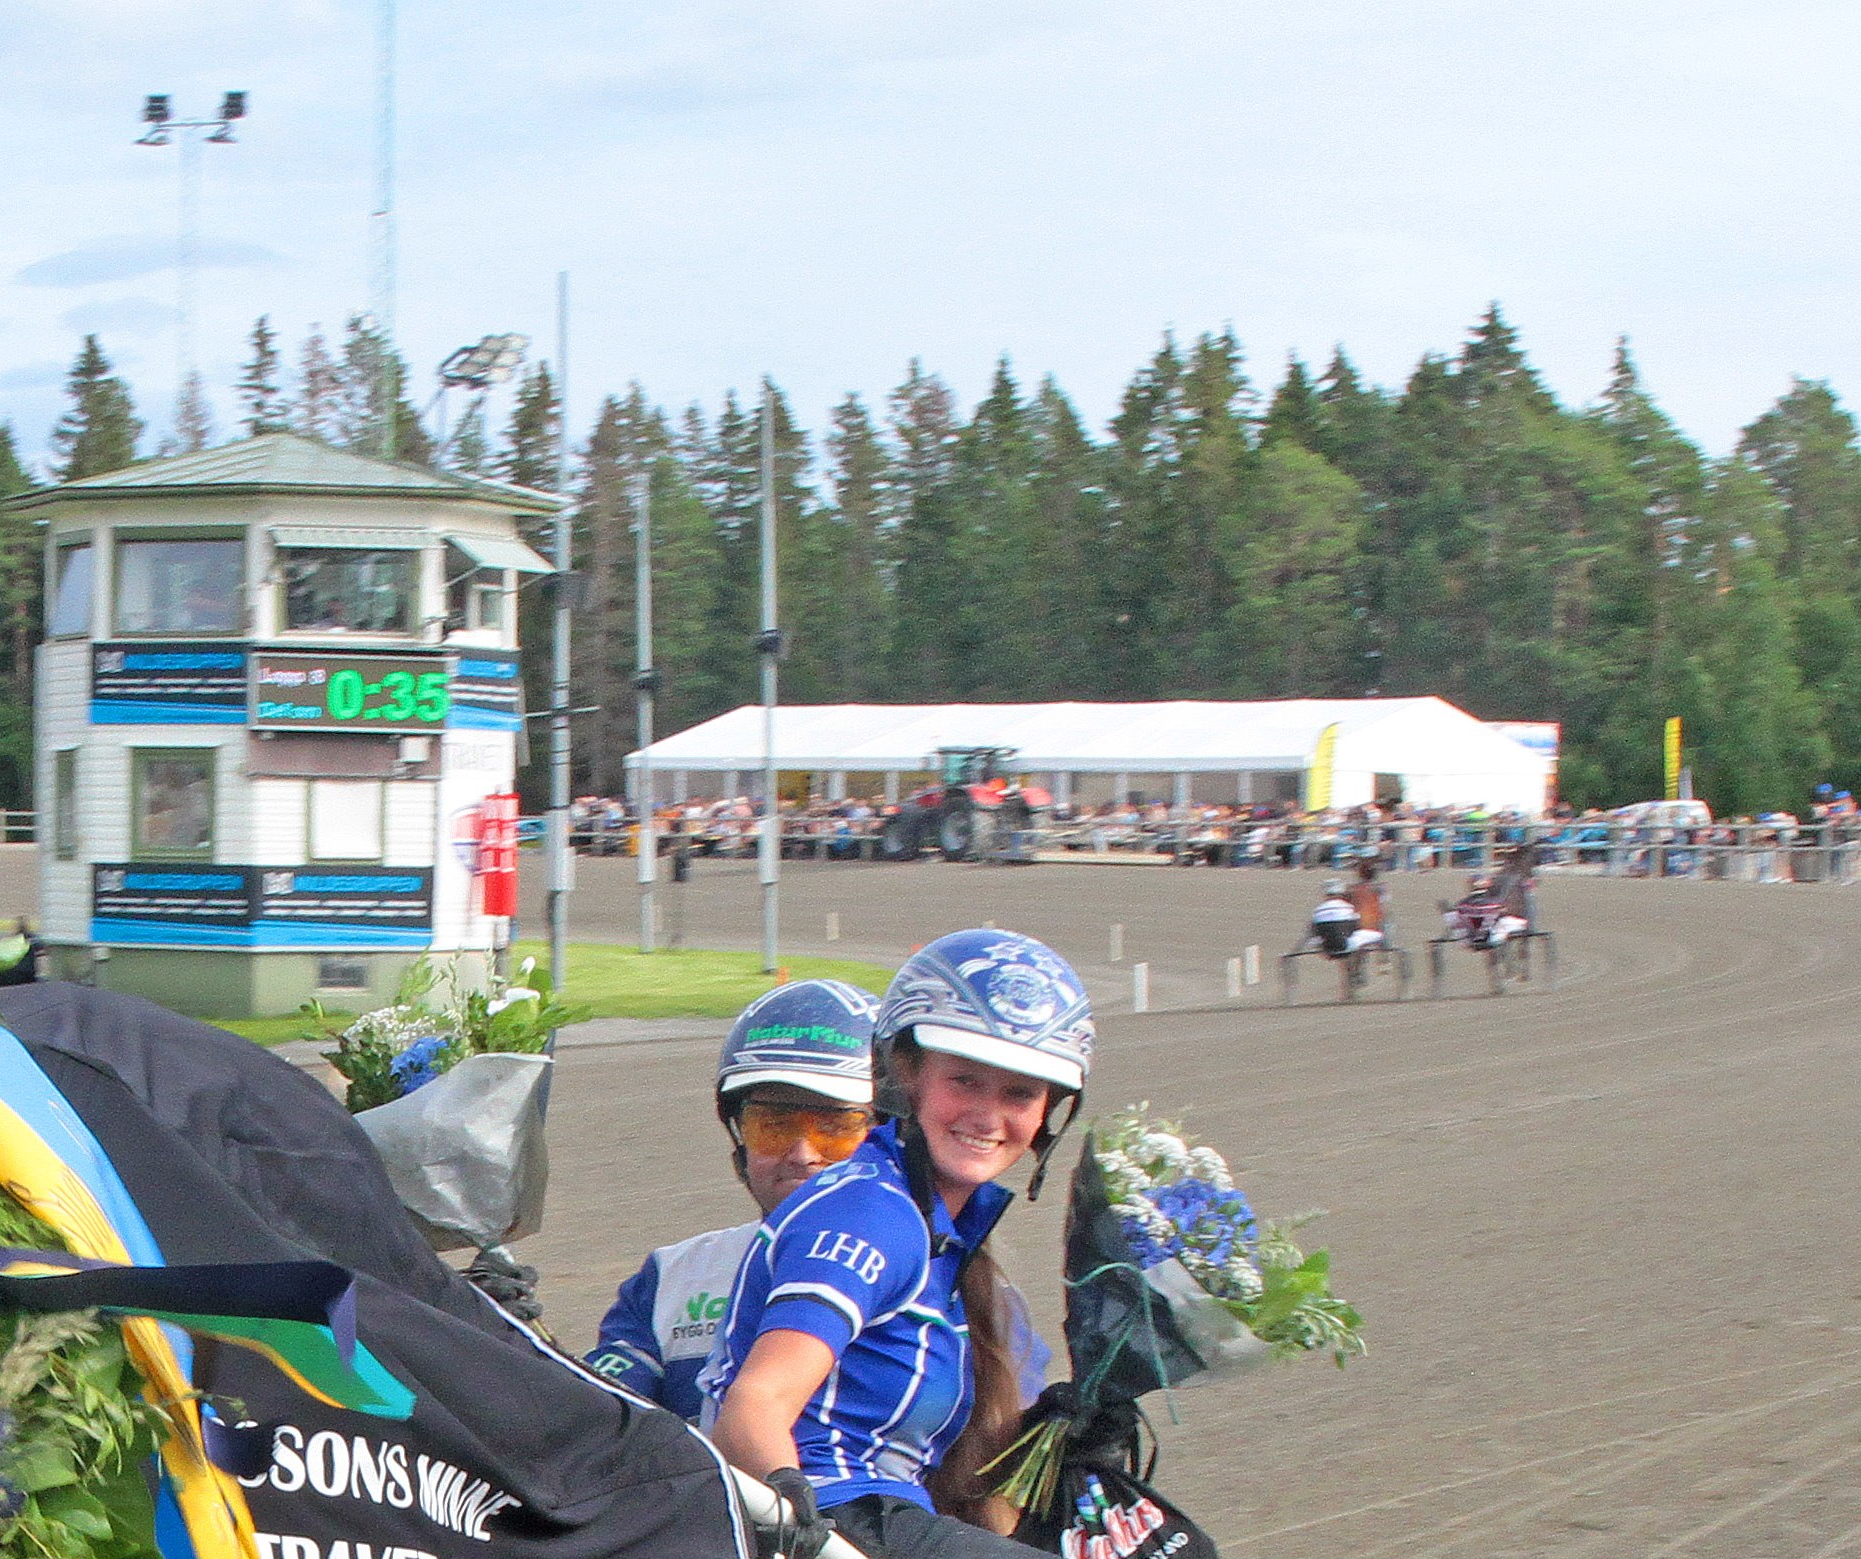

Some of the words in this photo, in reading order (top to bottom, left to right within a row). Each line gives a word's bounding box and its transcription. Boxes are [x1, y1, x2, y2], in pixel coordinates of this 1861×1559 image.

[326, 669, 452, 723] 0:35
[804, 1229, 887, 1286] LHB
[210, 1416, 413, 1509] SONS
[417, 1453, 523, 1543] MINNE
